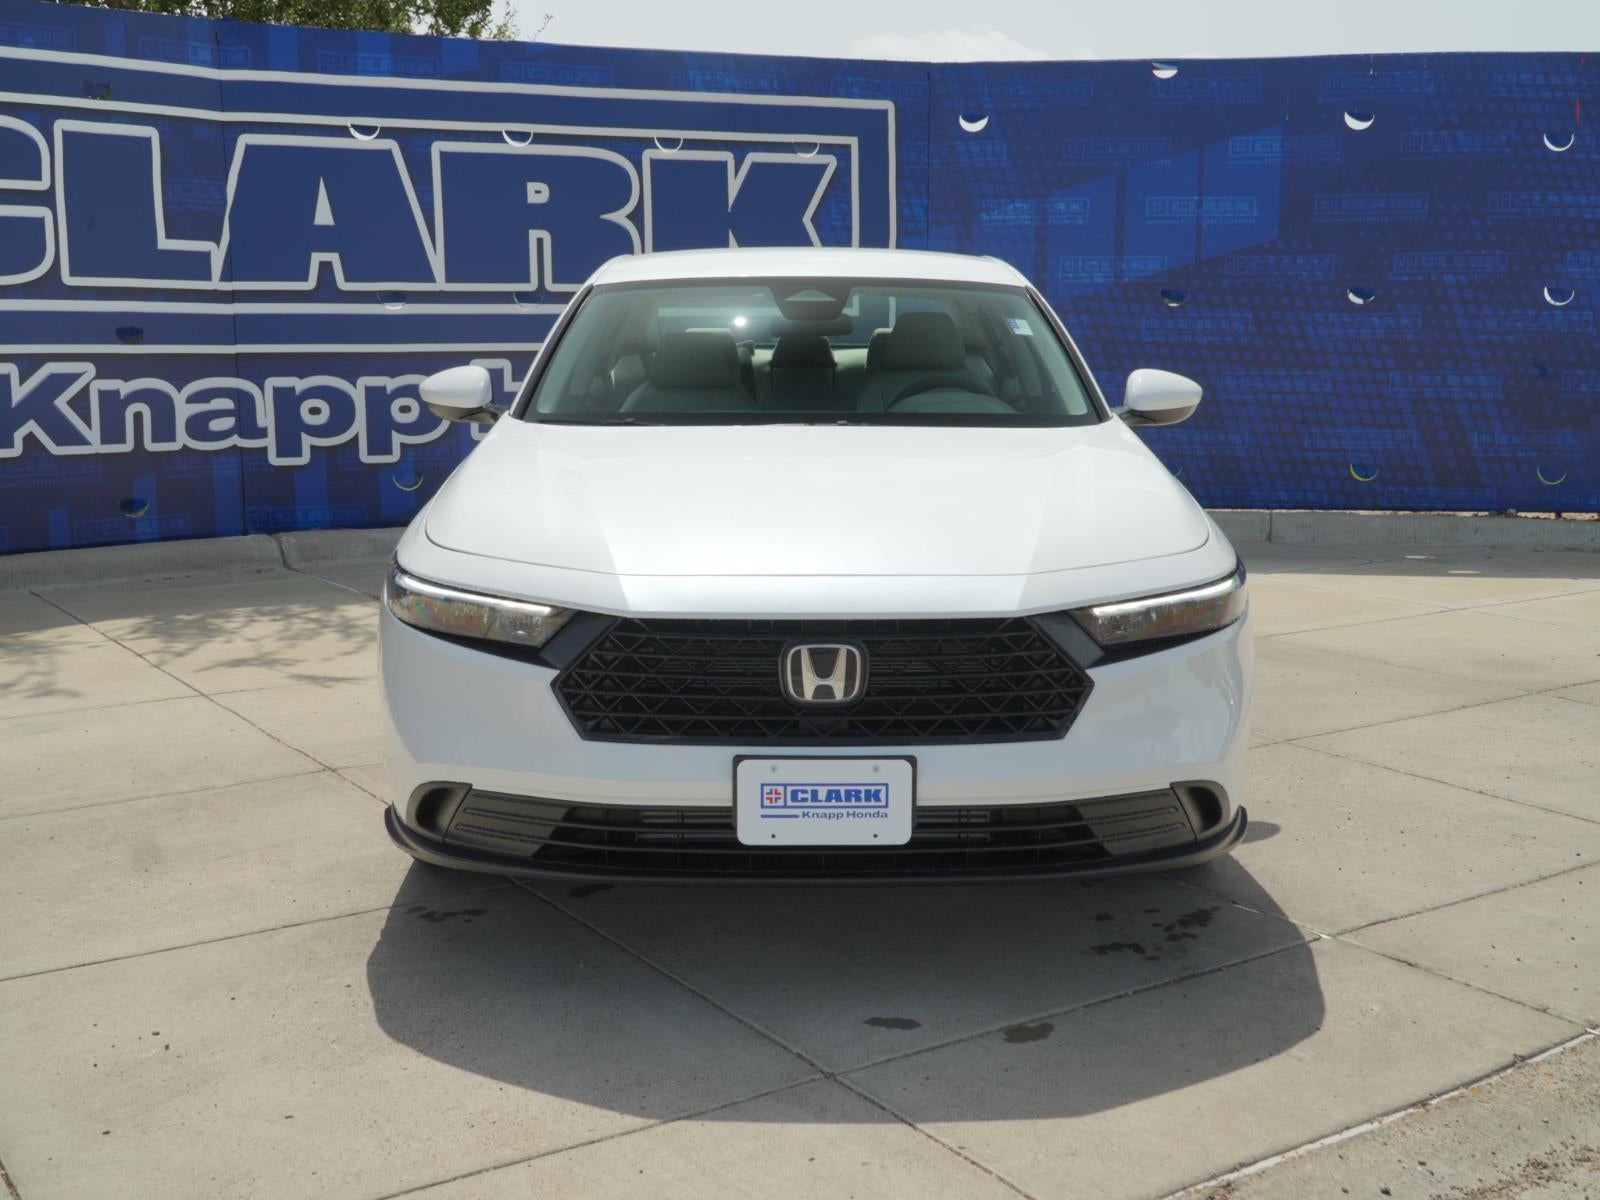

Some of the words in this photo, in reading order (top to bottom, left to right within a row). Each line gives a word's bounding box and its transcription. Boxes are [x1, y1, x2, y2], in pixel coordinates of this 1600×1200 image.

[0, 114, 838, 292] LARK
[0, 361, 451, 466] Knapp
[790, 788, 882, 803] CLARK
[802, 811, 844, 820] Knapp
[846, 811, 888, 819] Honda
